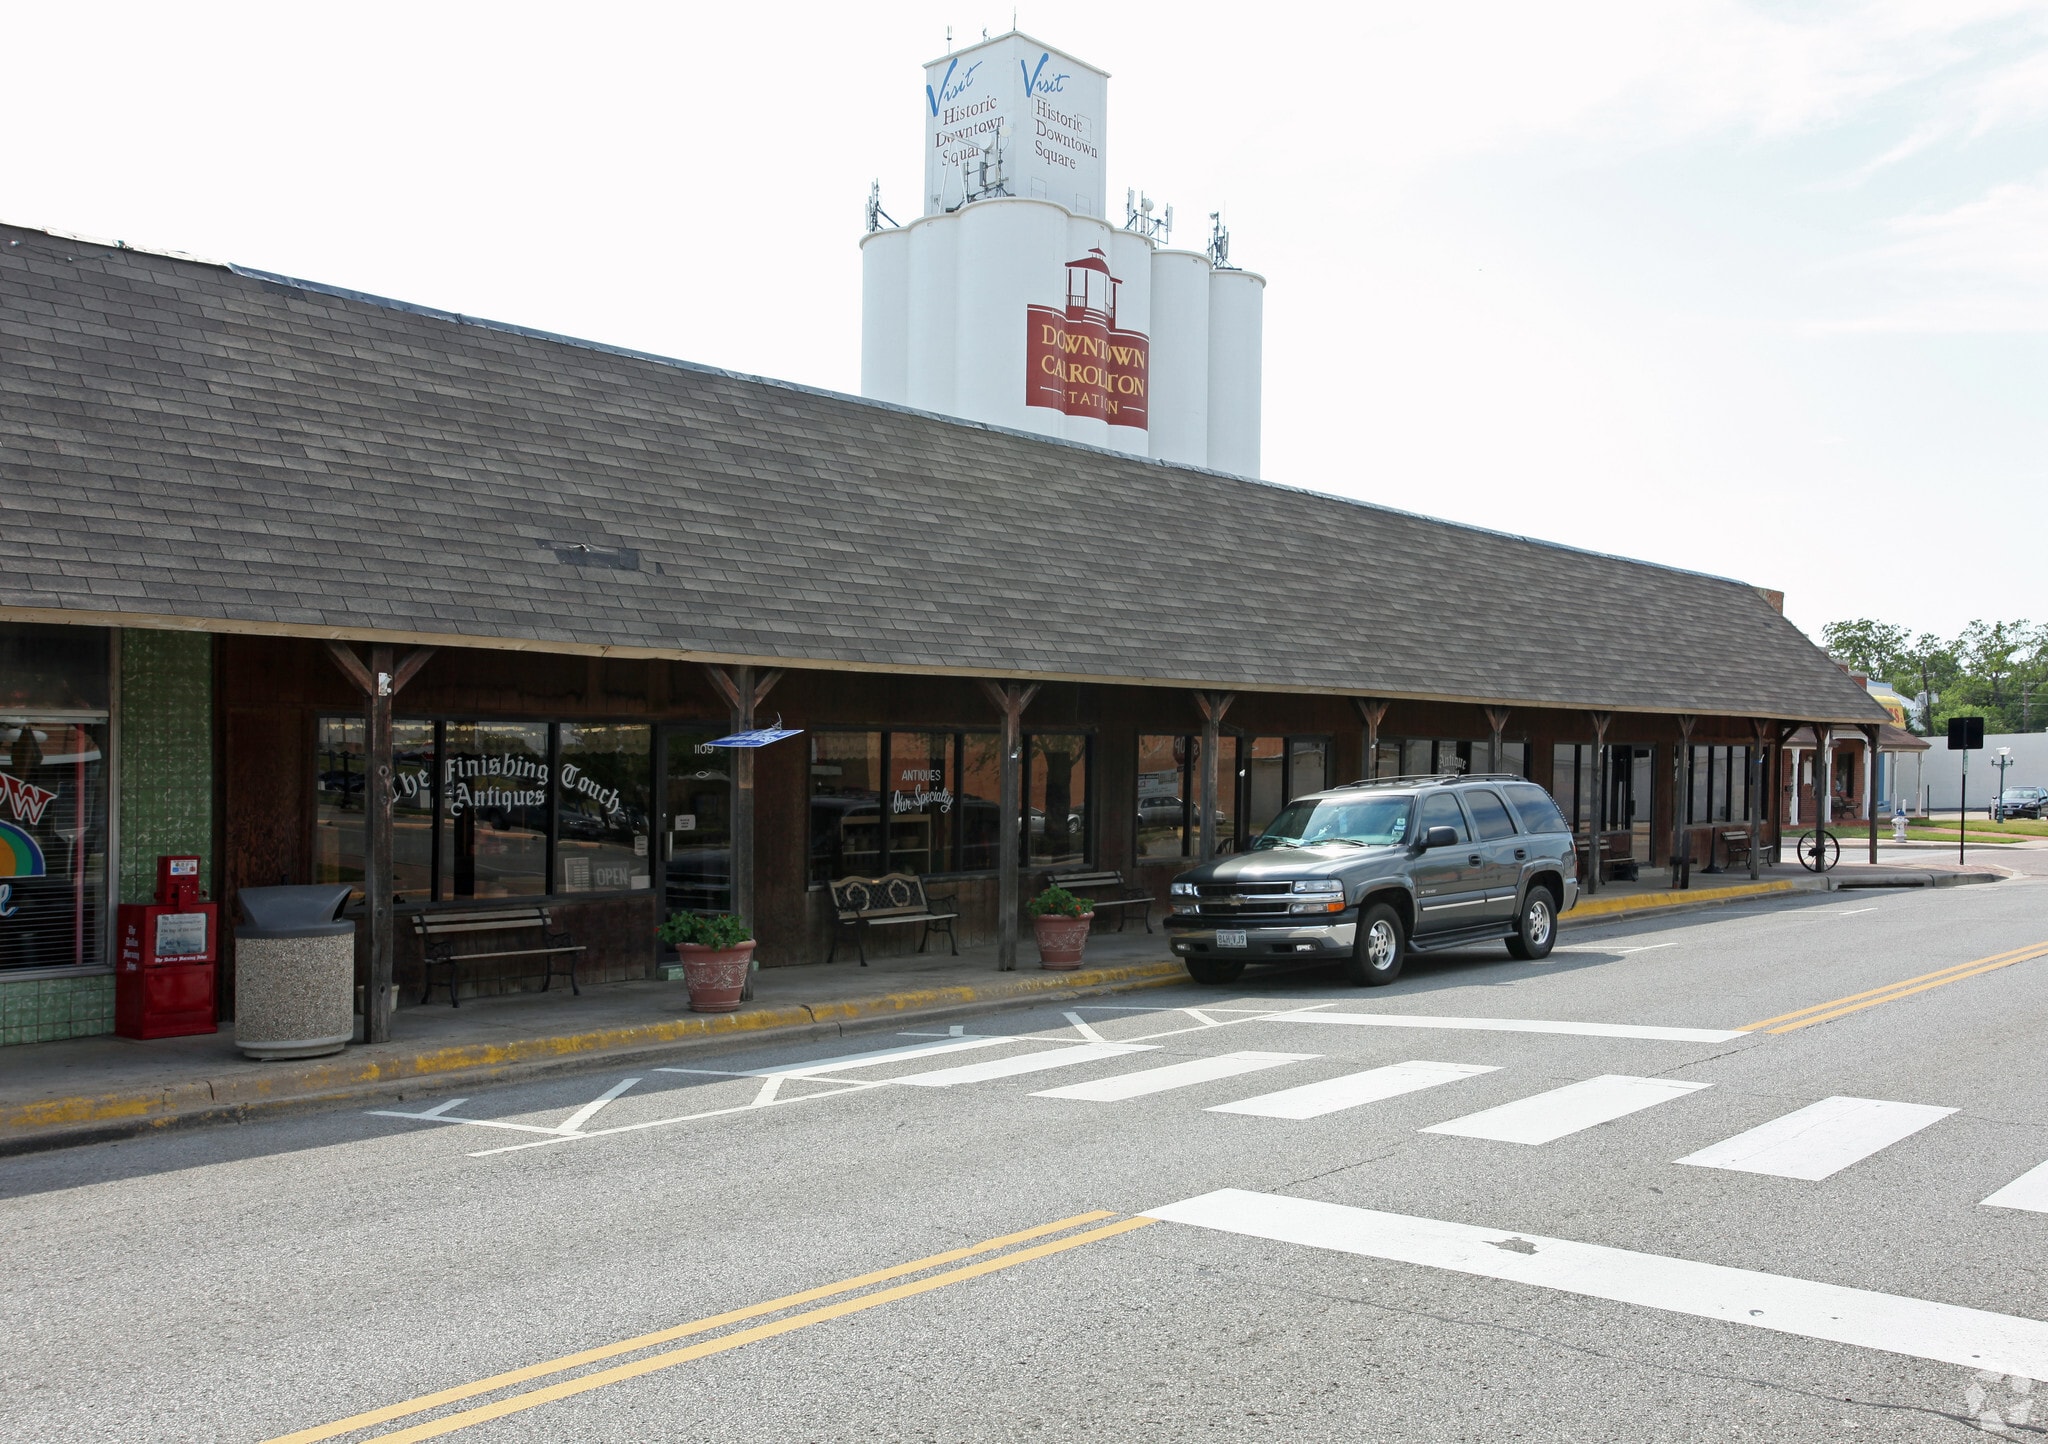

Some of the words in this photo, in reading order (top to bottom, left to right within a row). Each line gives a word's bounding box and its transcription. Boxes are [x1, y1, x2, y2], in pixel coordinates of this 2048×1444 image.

[926, 57, 983, 117] Visit
[1020, 52, 1071, 98] Visit
[943, 95, 998, 126] Historic
[1036, 98, 1083, 132] Historic
[942, 144, 982, 167] Squar
[1035, 140, 1077, 170] Square
[1036, 119, 1098, 158] Downtown
[1041, 324, 1145, 370] DOWNTOWN
[444, 752, 549, 786] Finishing
[561, 763, 620, 815] Touch
[901, 769, 941, 781] ANTIQUES
[0, 772, 57, 825] W
[450, 782, 545, 816] Antiques
[893, 790, 912, 814] Our
[913, 784, 954, 814] Specialty
[596, 867, 629, 886] OPEN
